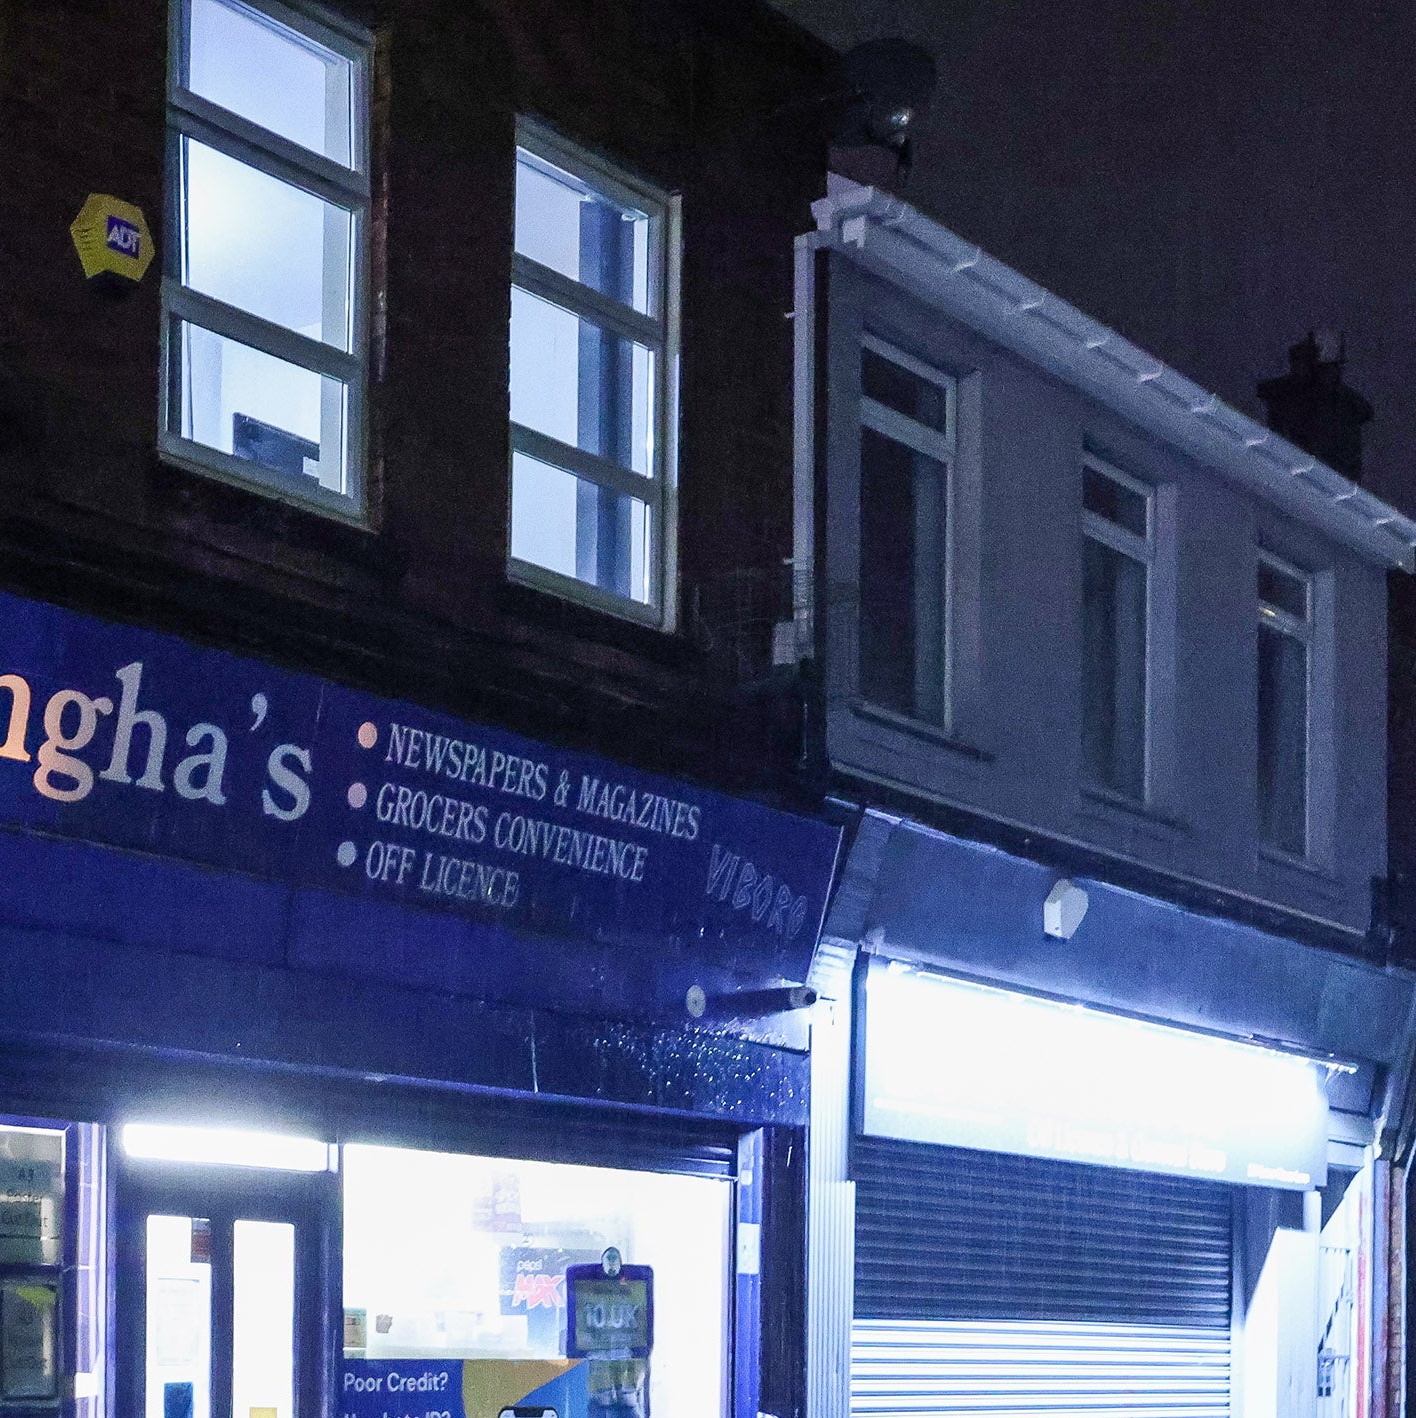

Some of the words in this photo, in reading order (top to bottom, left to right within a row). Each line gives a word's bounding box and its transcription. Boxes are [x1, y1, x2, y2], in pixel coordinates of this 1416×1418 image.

[106, 224, 142, 252] ADT
[386, 722, 549, 800] NEWSPAPERS
[553, 770, 572, 807] &
[577, 776, 701, 840] MAGAZINES
[376, 782, 489, 843] GROCERS
[494, 812, 649, 882] CONVENIENCE
[365, 840, 414, 886] OFF
[419, 851, 520, 908] LICENCE
[344, 1372, 383, 1392] Poor
[387, 1371, 449, 1393] Credit?
